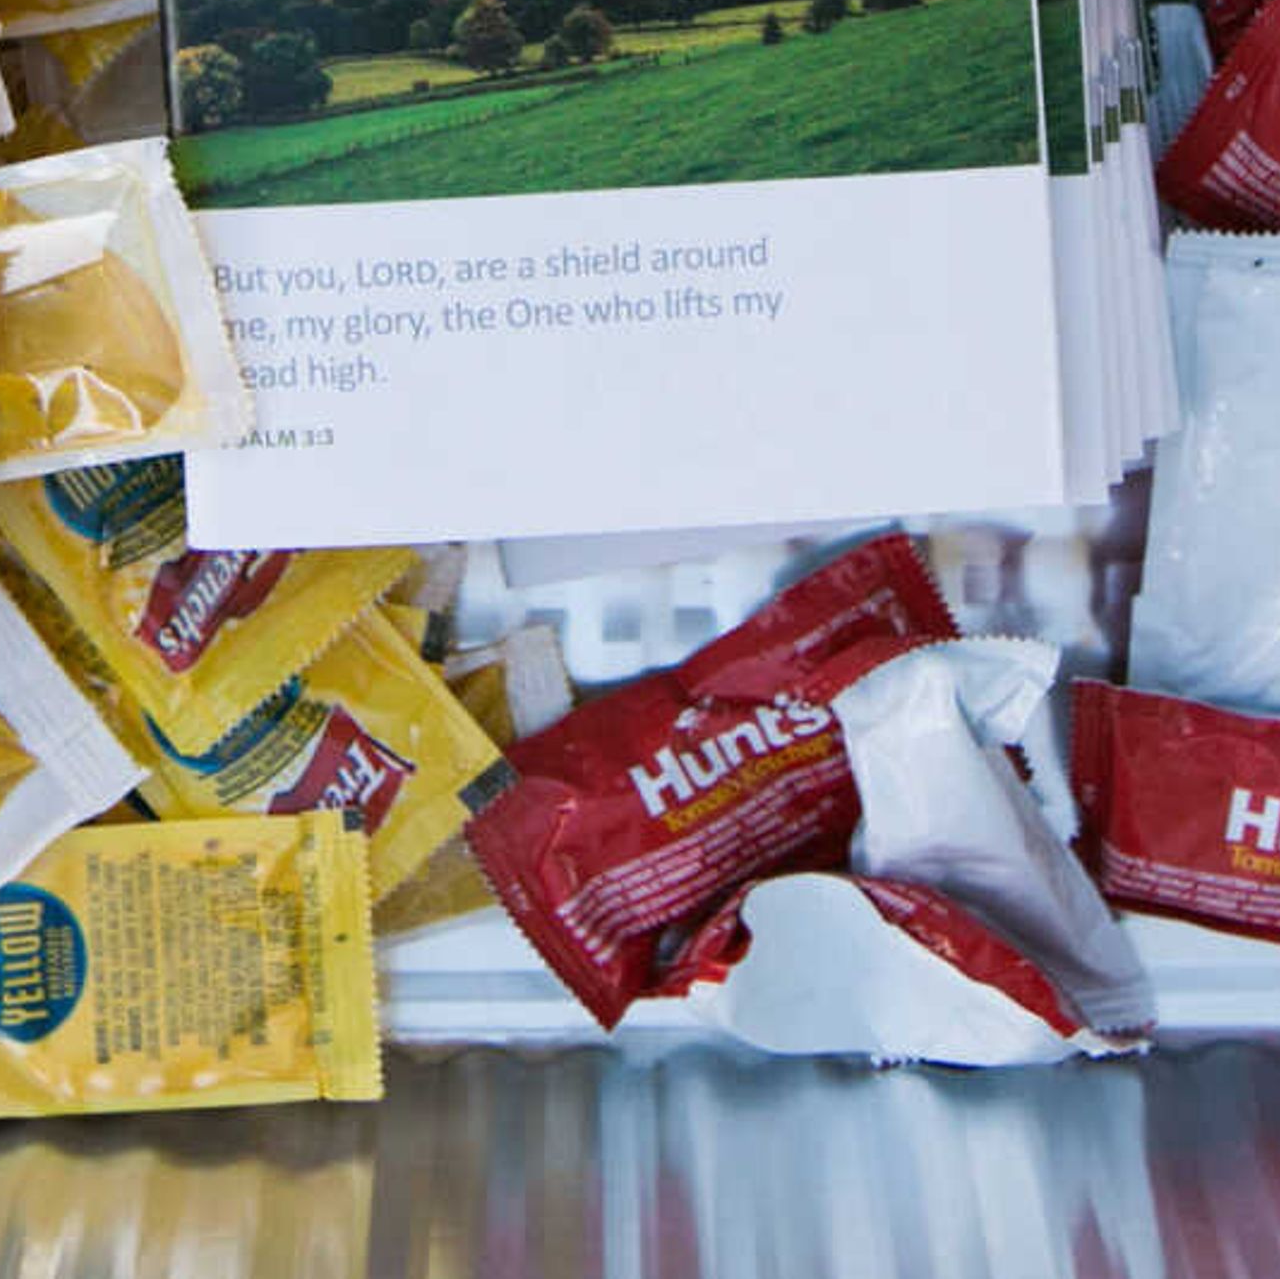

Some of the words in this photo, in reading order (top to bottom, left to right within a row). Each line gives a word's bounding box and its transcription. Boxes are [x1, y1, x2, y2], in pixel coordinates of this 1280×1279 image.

[214, 264, 269, 293] But
[277, 266, 346, 296] you,
[455, 258, 507, 282] are
[516, 257, 536, 279] a
[545, 243, 640, 277] shield
[651, 237, 768, 272] around
[286, 314, 334, 343] my
[344, 305, 432, 345] glory,
[442, 302, 497, 332] the
[506, 298, 573, 328] One
[584, 294, 655, 322] who
[664, 287, 723, 319] lifts
[733, 289, 783, 321] my
[239, 357, 297, 390] ead
[308, 354, 389, 392] high.
[627, 691, 834, 819] Hunt's
